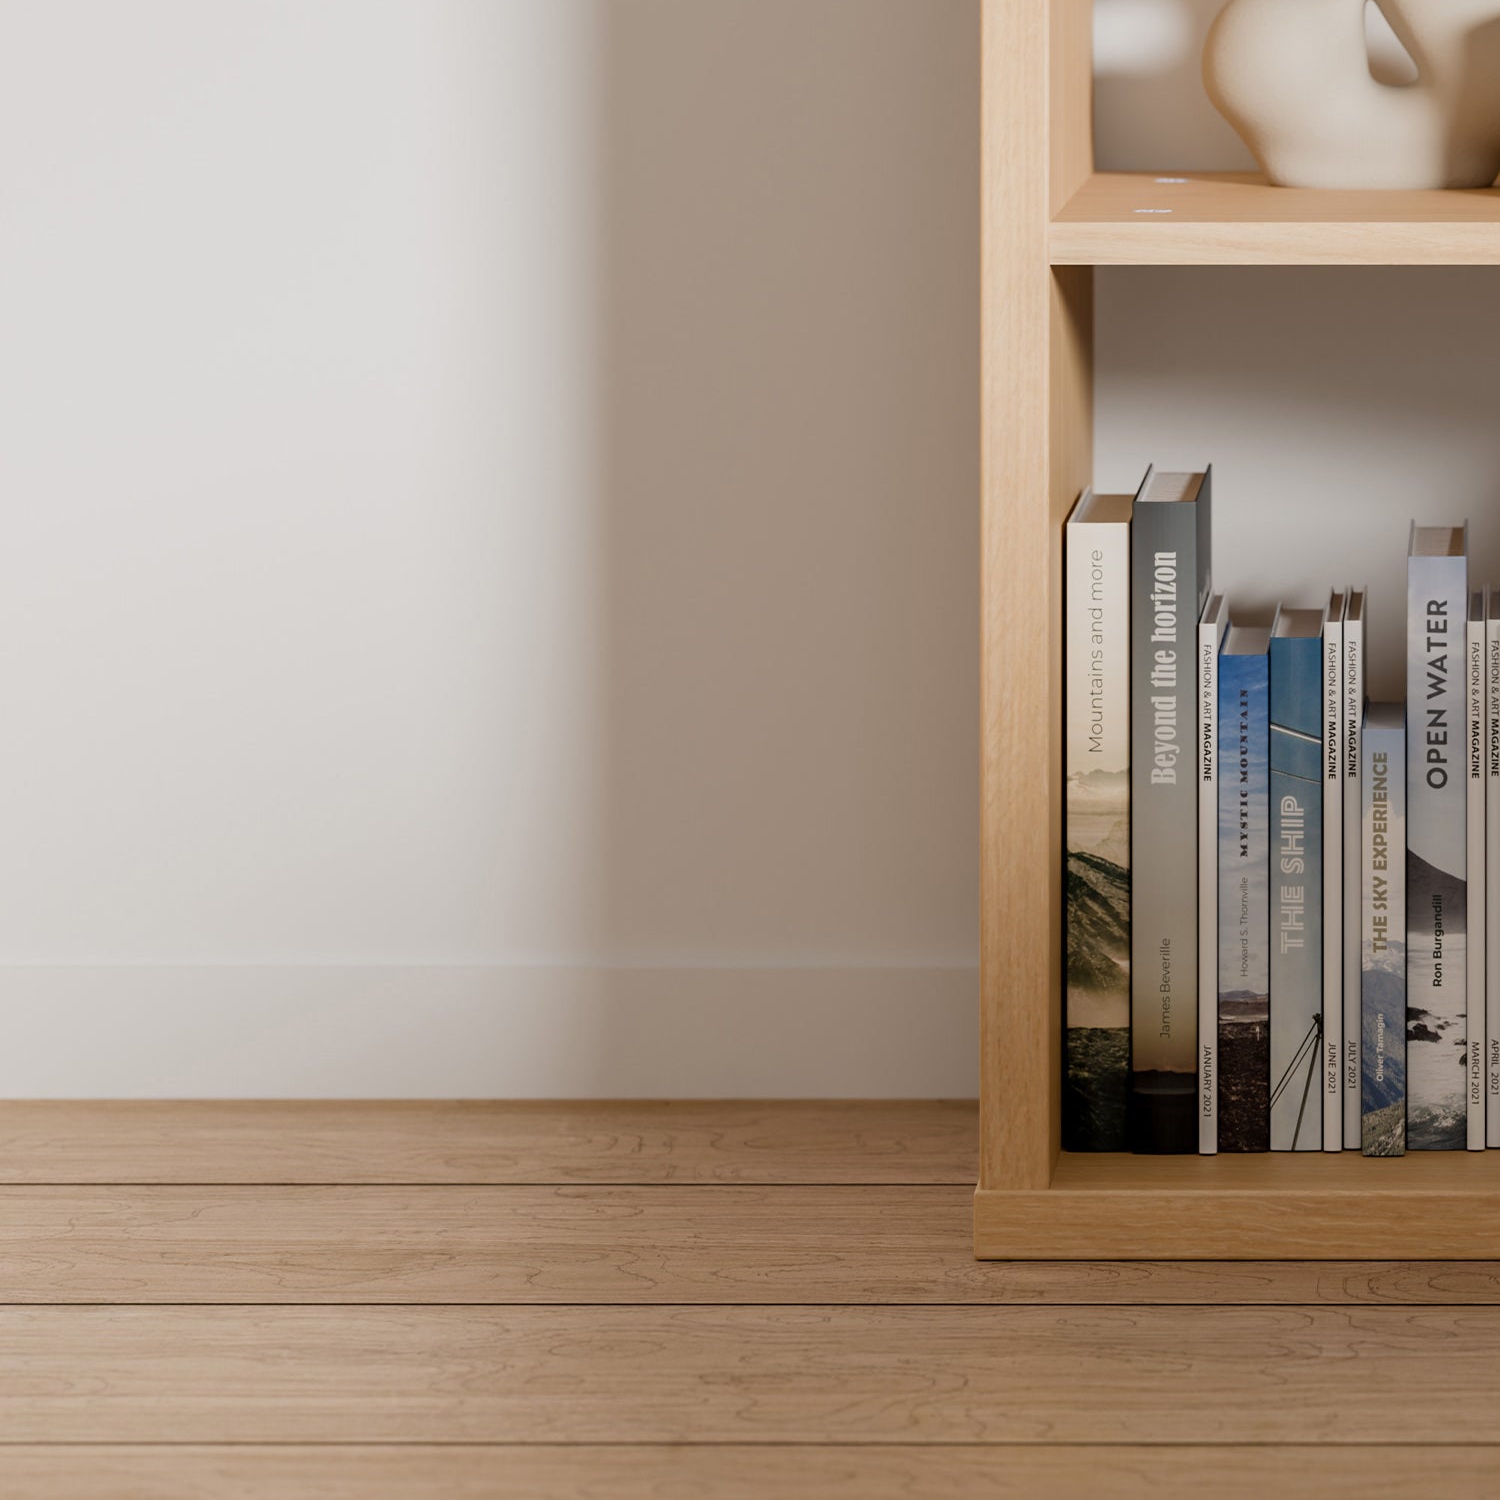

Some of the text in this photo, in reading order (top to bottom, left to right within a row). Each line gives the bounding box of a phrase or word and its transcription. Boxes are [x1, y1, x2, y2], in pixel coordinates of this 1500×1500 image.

[1088, 549, 1103, 752] Mountains and more
[1150, 551, 1180, 785] Beyond the horizon
[1203, 644, 1212, 782] FASHION & ART MAGAZINE
[1328, 642, 1336, 780] FASHION & ART MAGAZINE
[1348, 641, 1356, 778] FASHION & ART MAGAZINE
[1426, 599, 1448, 789] OPEN WATER
[1471, 642, 1479, 779] FASHION & ART MAGAZINE
[1491, 640, 1499, 777] FASHION & ART MAGAZINE
[1240, 689, 1248, 858] MYSTIC MOUNTAIN
[1280, 795, 1304, 954] THE SHIP
[1372, 752, 1387, 953] THE SKY EXPERIENCE
[1159, 937, 1171, 1039] James Beverille
[1240, 877, 1248, 977] Howard S. Thornville
[1432, 894, 1444, 987] Ron Burgandill
[1203, 1044, 1212, 1117] JANUARY 2021
[1328, 1042, 1336, 1094] JUNE 2021
[1348, 1040, 1356, 1089] JULY 2021
[1376, 1013, 1385, 1082] Oliver Tamagin
[1471, 1041, 1479, 1105] MARCH 2021
[1491, 1039, 1499, 1096] APRIL 2021
